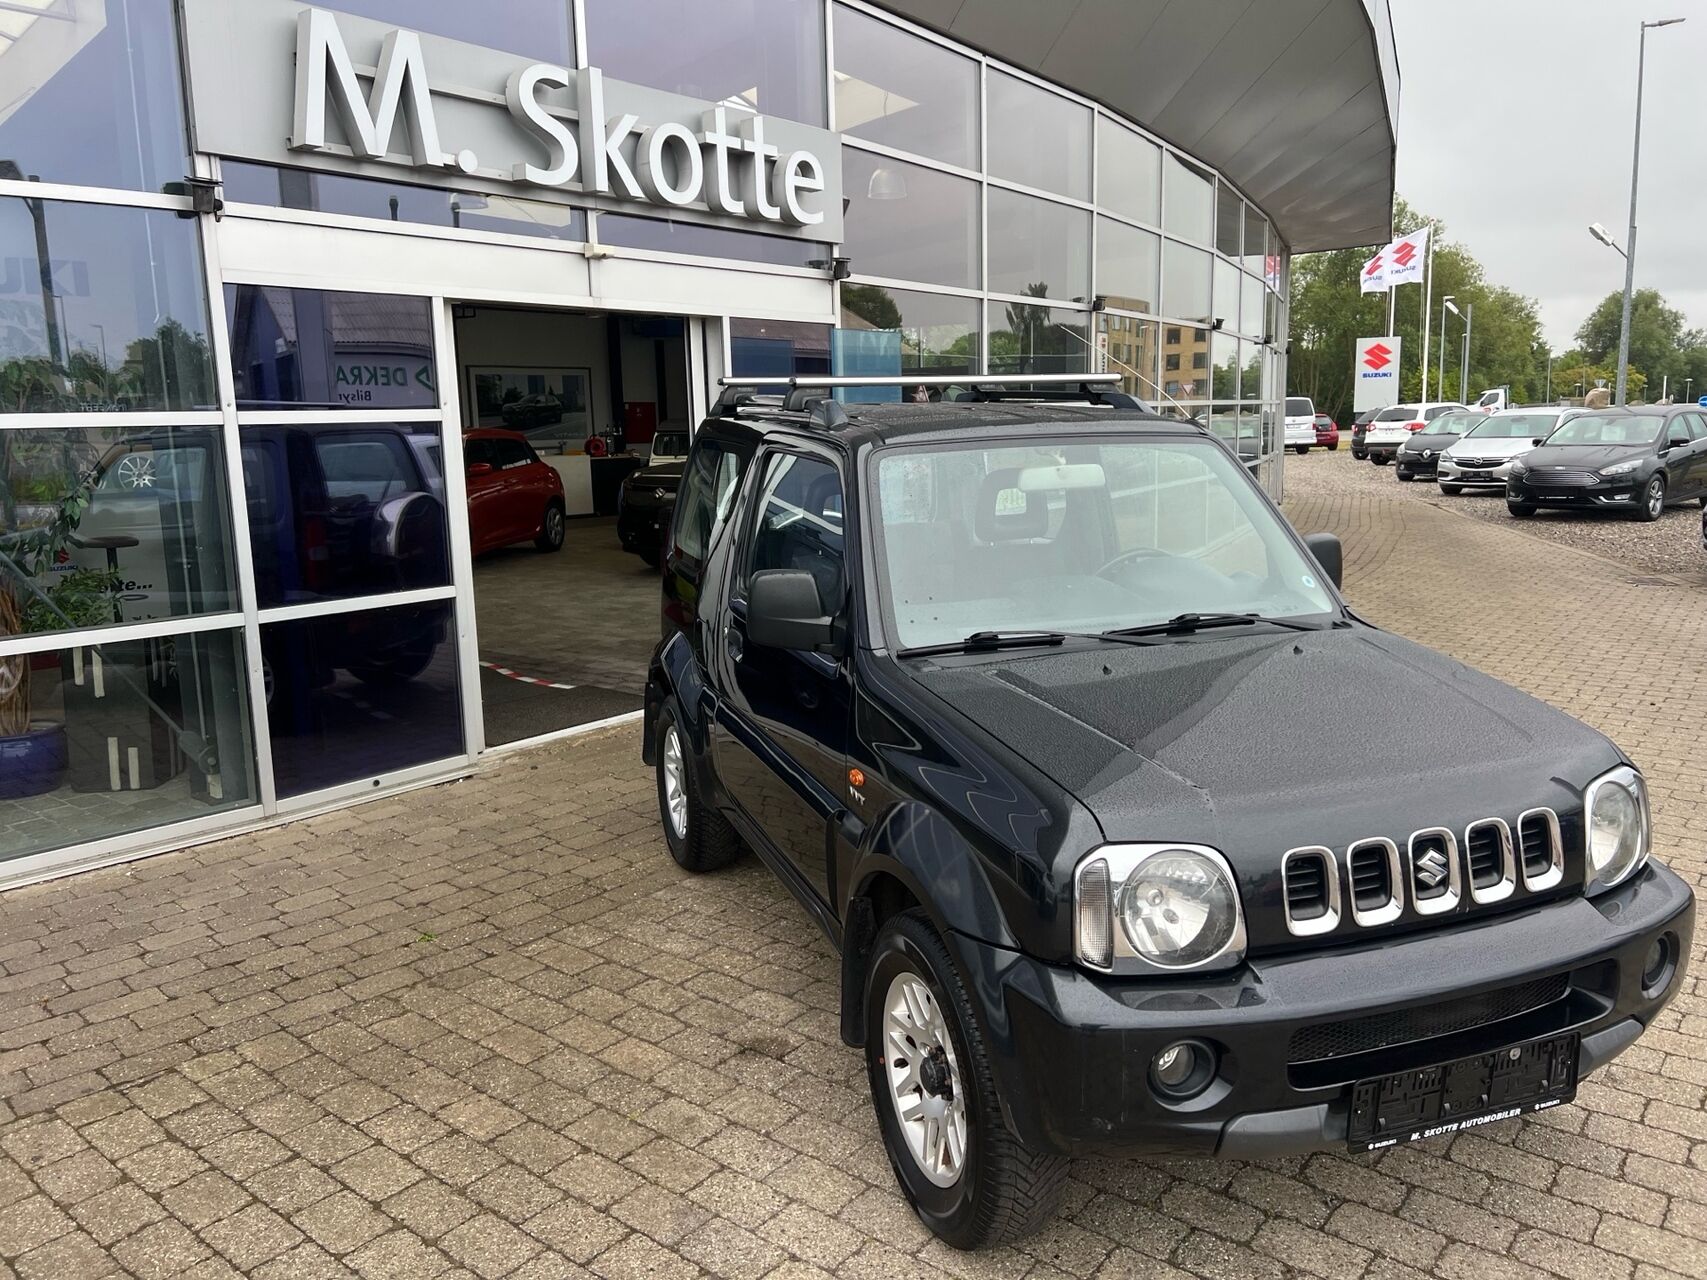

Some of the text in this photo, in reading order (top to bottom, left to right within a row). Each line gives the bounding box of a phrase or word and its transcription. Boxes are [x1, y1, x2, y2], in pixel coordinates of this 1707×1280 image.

[297, 8, 824, 226] M. Skotte
[1362, 371, 1392, 379] SUZUKI
[1410, 1108, 1521, 1141] M. SKOTTE AUTOMOBILER
